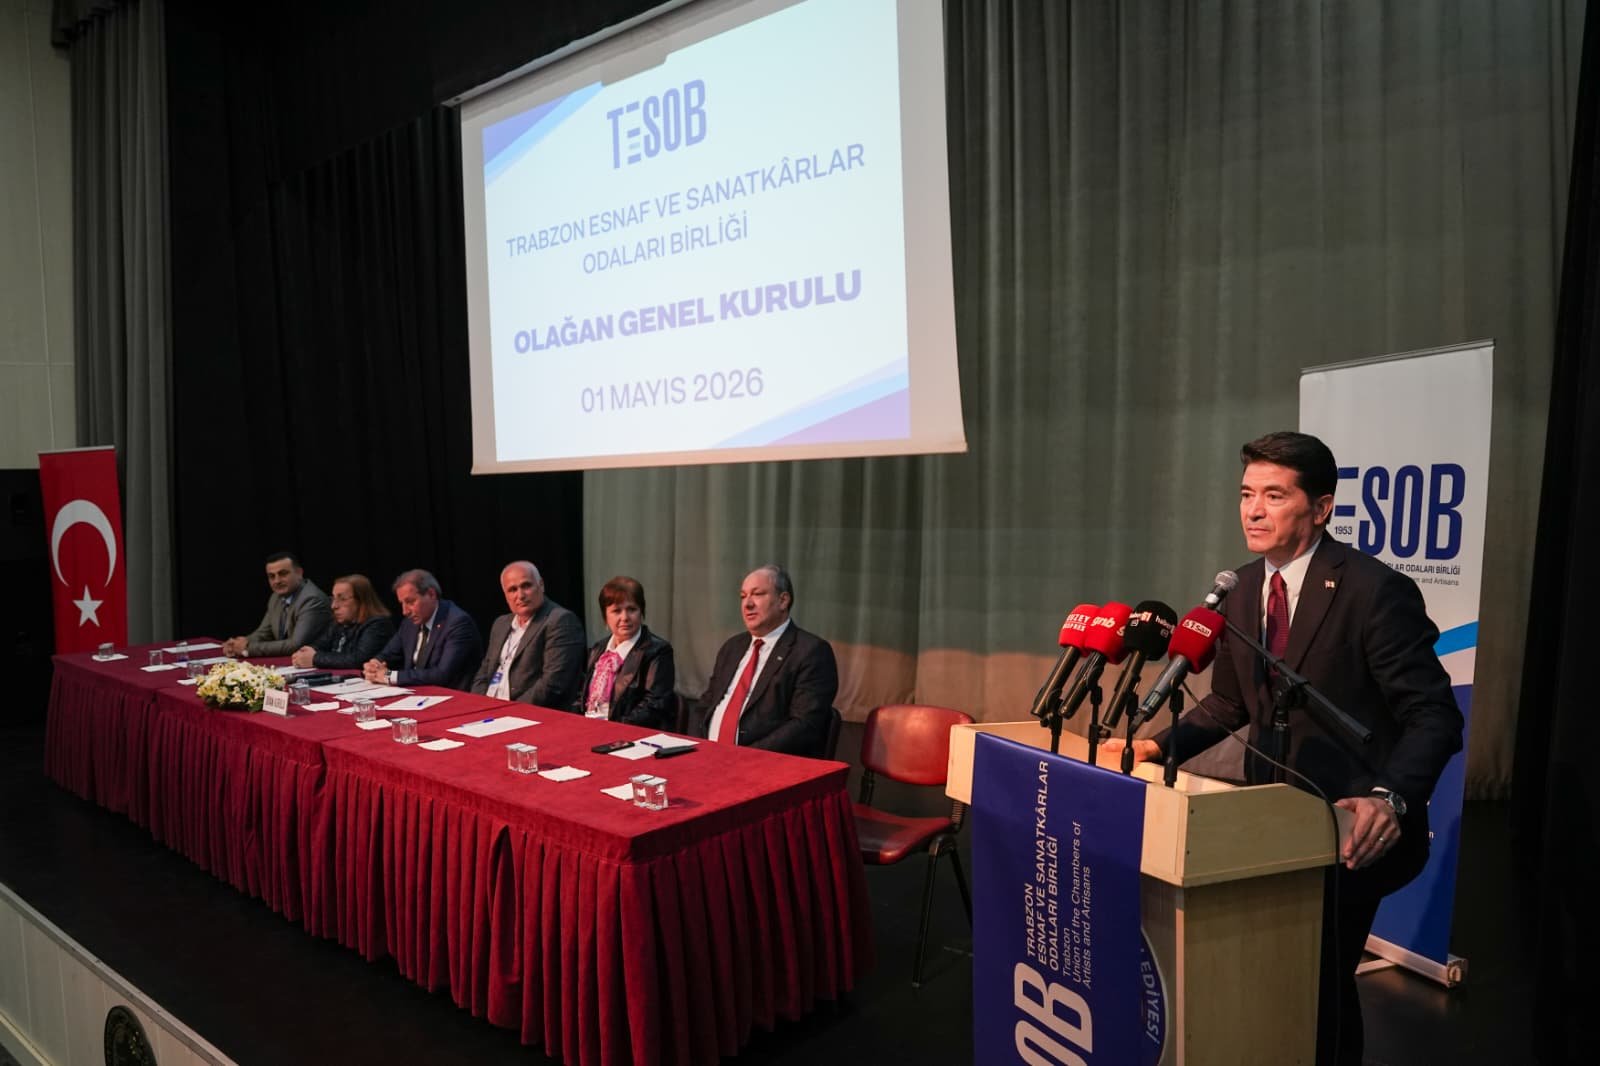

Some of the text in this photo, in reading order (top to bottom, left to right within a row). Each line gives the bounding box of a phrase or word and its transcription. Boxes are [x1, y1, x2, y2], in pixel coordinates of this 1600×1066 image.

[606, 79, 707, 169] TESOB
[506, 143, 866, 257] TRABZON ESNAF VE SANATKÂRLAR
[583, 209, 749, 274] ODALARI BİRLİĞİ
[514, 269, 862, 354] OLAĞAN GENEL KURULU
[581, 367, 764, 412] 01 MAYIS 2026
[1334, 463, 1465, 560] ESOB
[1335, 526, 1353, 535] 1953
[1406, 564, 1435, 574] ODALARI
[1436, 563, 1460, 575] BİRLİĞİ
[1024, 883, 1035, 957] TRABZON
[1036, 886, 1046, 907] VE
[1046, 836, 1059, 971] ODALARI BİRLİĞİ
[1071, 820, 1081, 983] Union of the Chambers of
[1081, 866, 1092, 990] Artists and Artisans
[1036, 911, 1047, 965] ESNAF
[1063, 927, 1071, 976] Trabzon
[1141, 960, 1161, 1045] EDİYESİ
